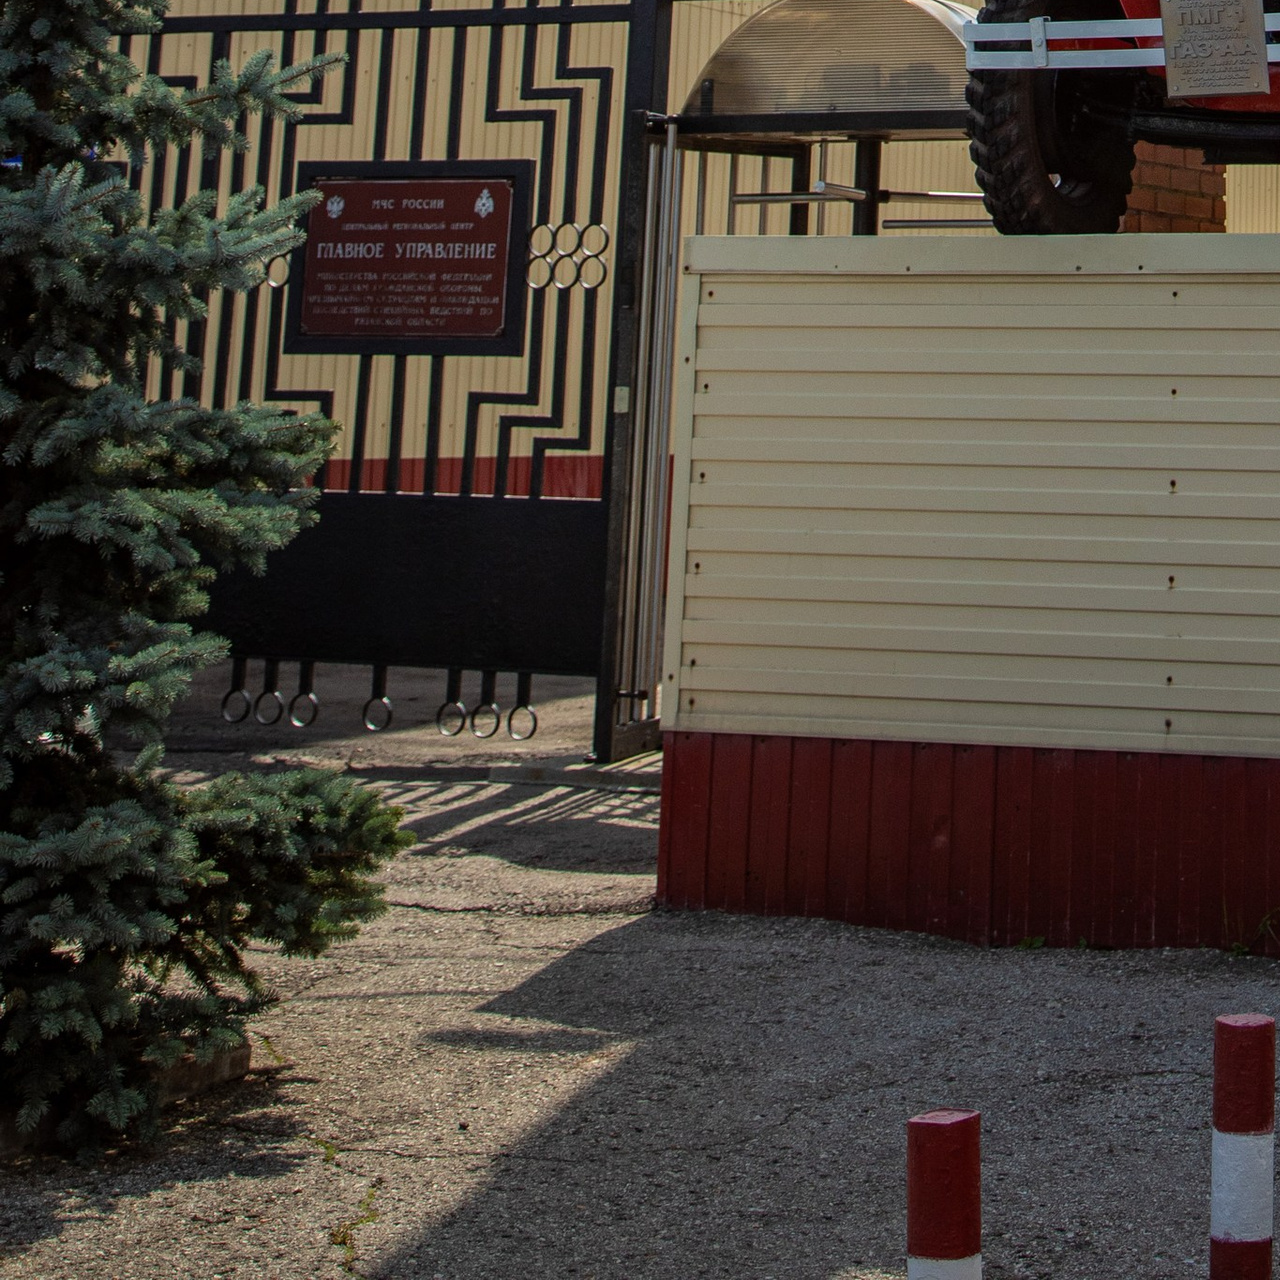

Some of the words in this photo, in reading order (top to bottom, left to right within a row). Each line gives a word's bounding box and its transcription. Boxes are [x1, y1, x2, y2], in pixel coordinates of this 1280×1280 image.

[372, 199, 395, 210] МЧС
[402, 198, 445, 209] РОССИИ
[316, 242, 385, 259] ГЛАВНОЕ
[395, 242, 497, 259] УПРАВЛЕНИЕ
